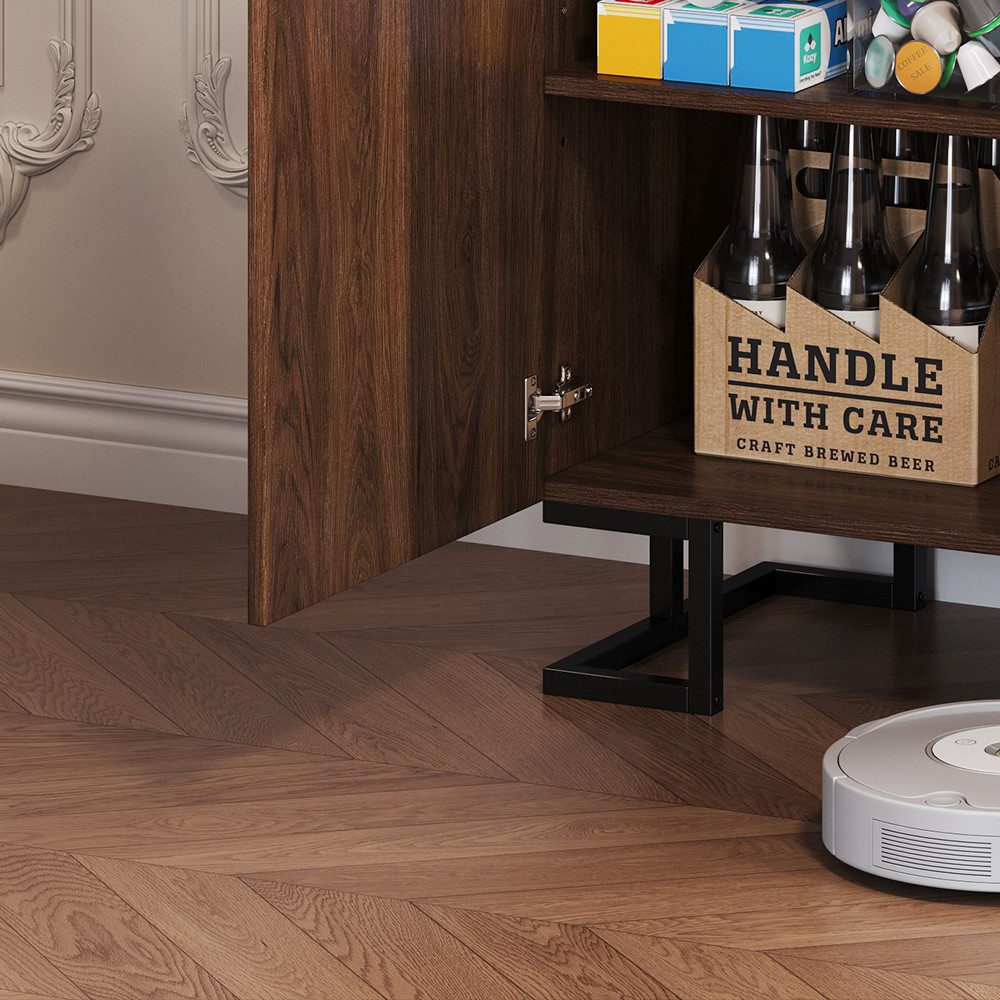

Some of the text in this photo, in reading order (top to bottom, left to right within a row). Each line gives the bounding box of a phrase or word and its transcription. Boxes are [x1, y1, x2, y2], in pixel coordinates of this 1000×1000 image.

[897, 45, 928, 71] COFFEE
[910, 62, 932, 81] SALE
[727, 335, 944, 396] HANDLE
[728, 393, 944, 444] WITH CARE
[736, 437, 935, 473] CRAFT BREWED BEER
